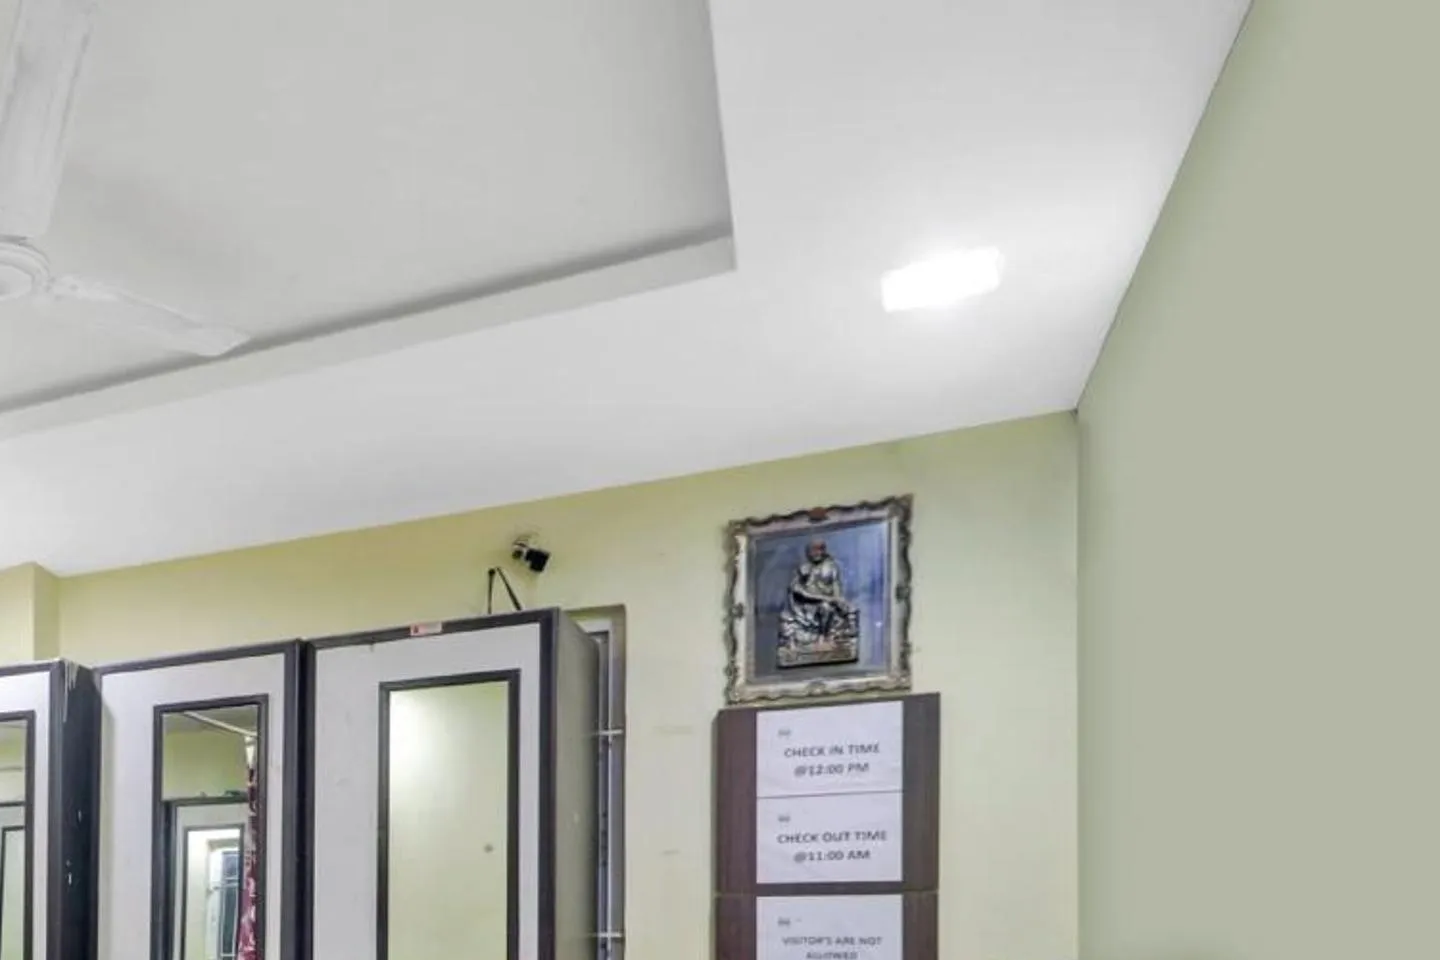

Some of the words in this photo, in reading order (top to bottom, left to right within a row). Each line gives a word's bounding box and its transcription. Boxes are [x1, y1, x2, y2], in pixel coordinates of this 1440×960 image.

[783, 746, 826, 758] CHECK
[829, 744, 845, 755] IN
[847, 742, 880, 754] TIME
[793, 763, 845, 777] @12:00
[847, 762, 870, 773] PM
[777, 832, 820, 844] CHECK
[821, 830, 851, 842] OUT
[854, 829, 887, 841] TIME
[793, 850, 845, 864] @11:00
[847, 849, 871, 860] AM
[835, 935, 857, 946] ARE
[859, 935, 883, 946] NOT
